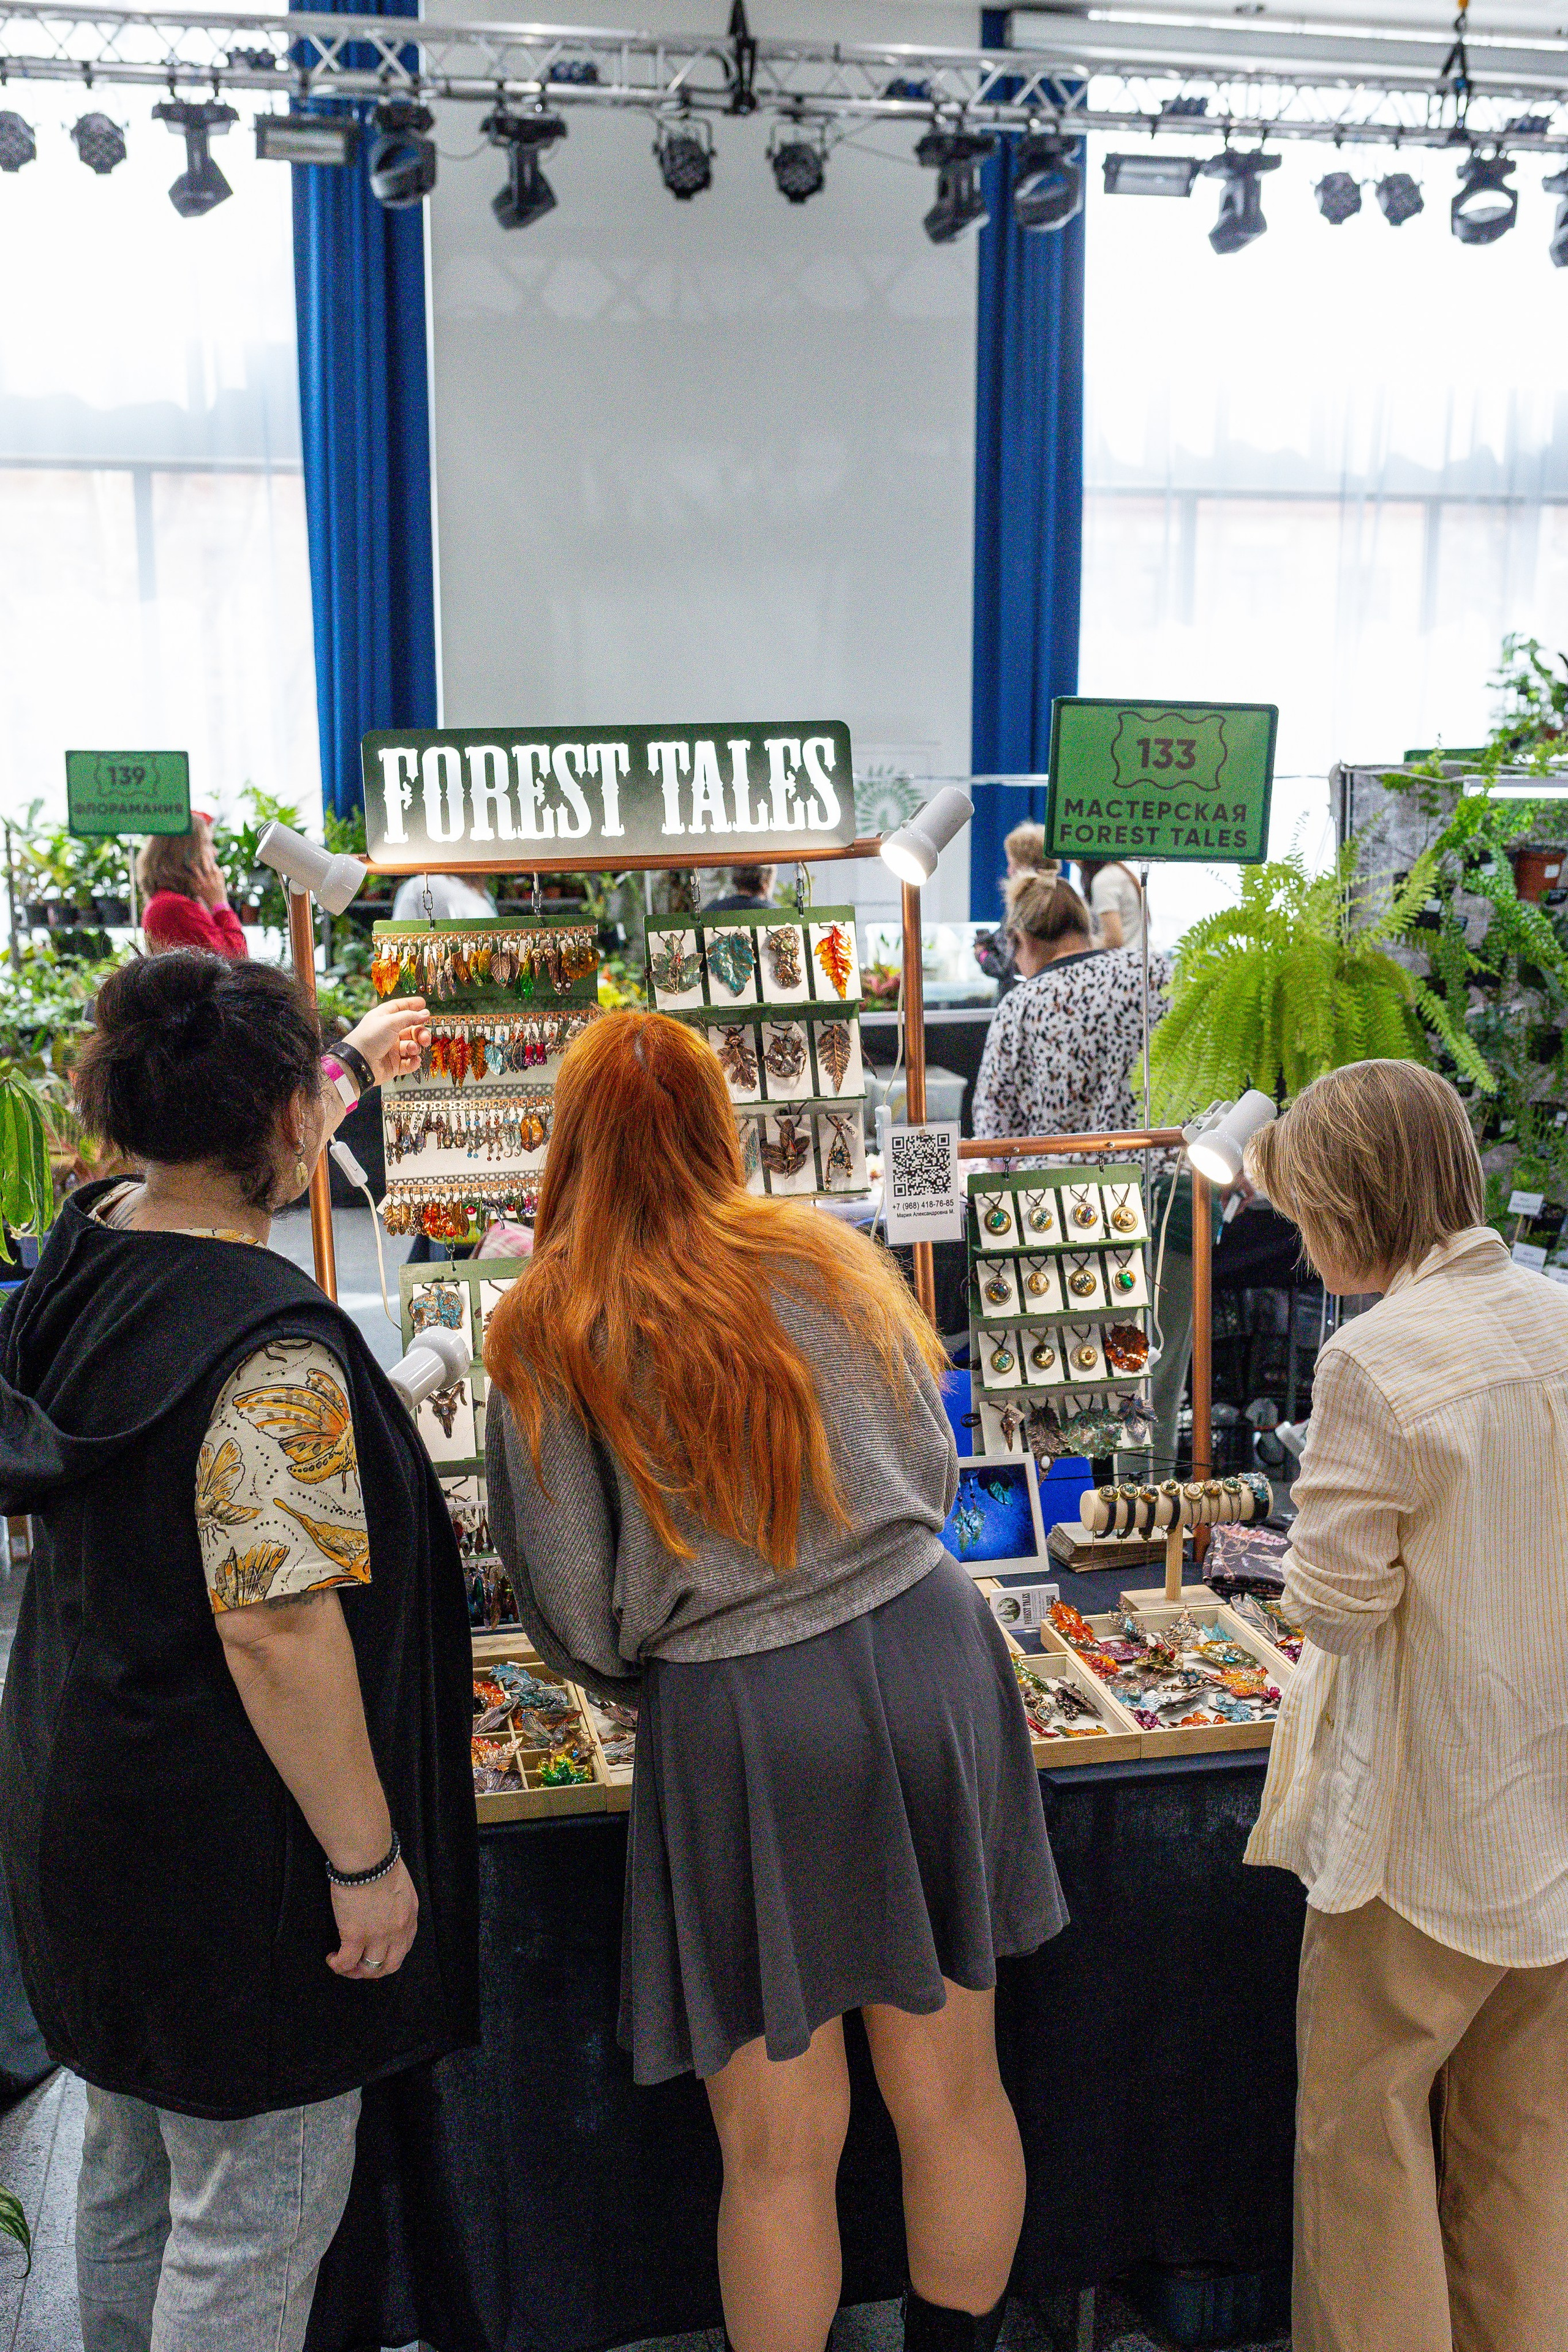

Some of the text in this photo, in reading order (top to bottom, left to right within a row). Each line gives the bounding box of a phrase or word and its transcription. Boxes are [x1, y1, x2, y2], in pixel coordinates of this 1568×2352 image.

[1137, 737, 1196, 770] 133
[107, 766, 146, 785] 139
[377, 737, 842, 845] FOREST TALES
[1063, 798, 1247, 823] МАСТЕРСКАЯ
[1060, 824, 1248, 848] FOREST TALES
[902, 1202, 919, 1212] (968)
[921, 1199, 954, 1208] 418-76-85
